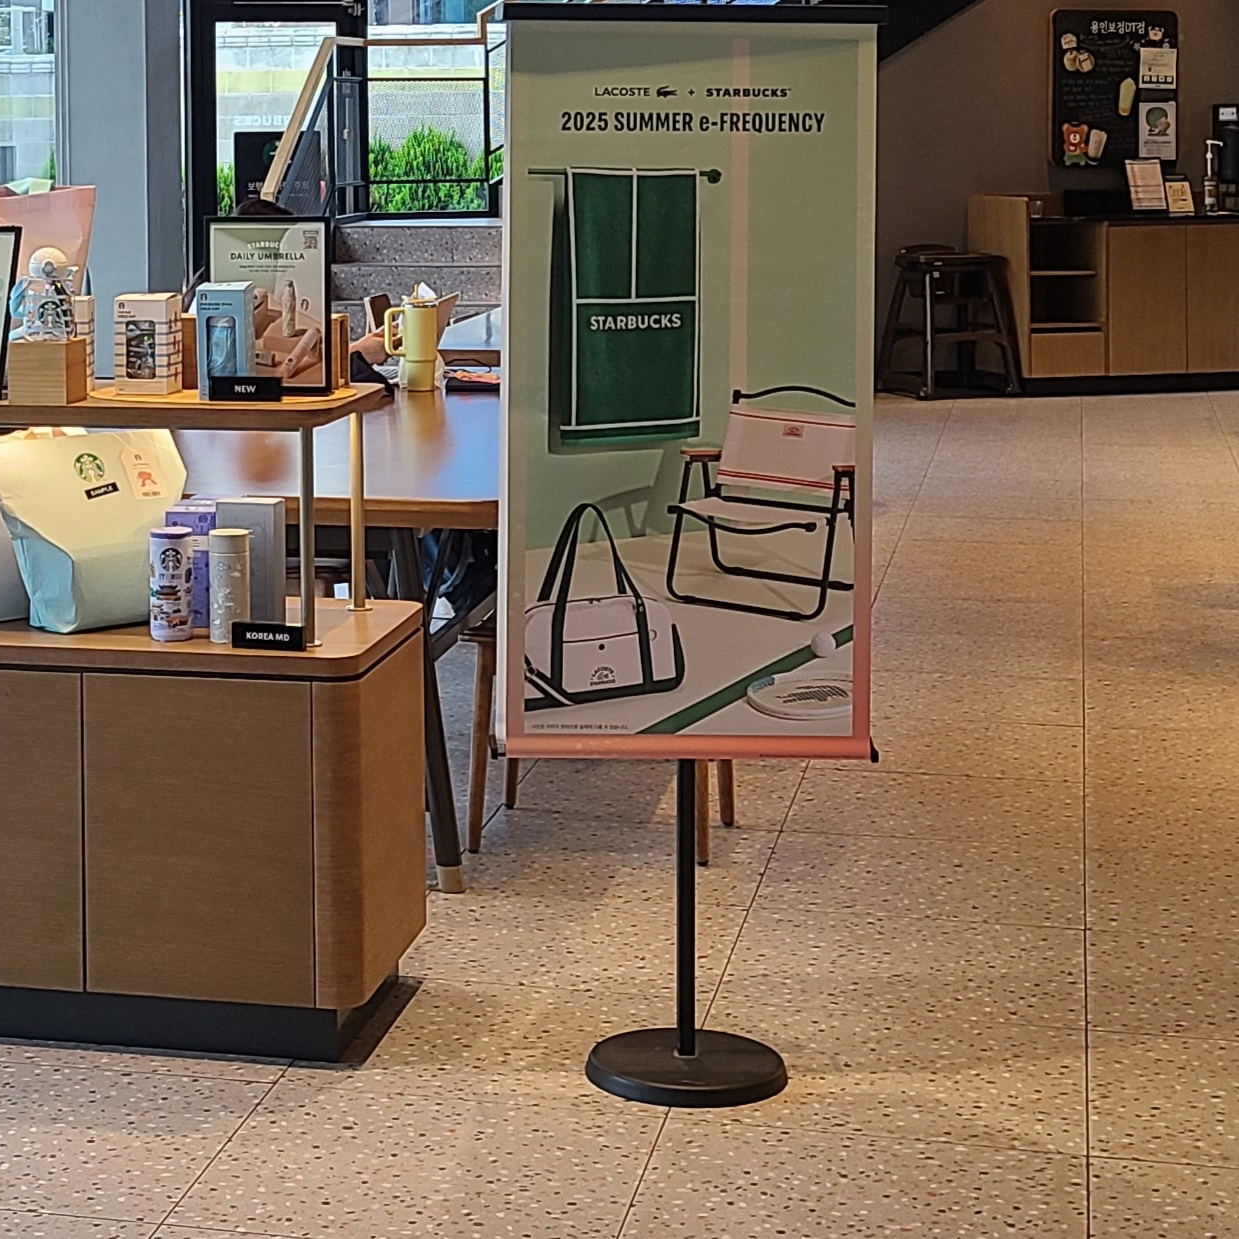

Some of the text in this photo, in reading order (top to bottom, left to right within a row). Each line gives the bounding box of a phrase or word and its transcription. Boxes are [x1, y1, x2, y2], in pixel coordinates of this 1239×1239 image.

[594, 87, 789, 98] LACOSTE STARBUCKS
[561, 111, 826, 134] 2025 SUMMER e-FREQUENCY
[247, 241, 287, 250] STARBUC
[230, 252, 306, 261] DAILY UMBRELLA
[589, 313, 682, 331] STARBUCKS
[234, 384, 257, 394] NEW
[245, 631, 290, 642] KOREA MD
